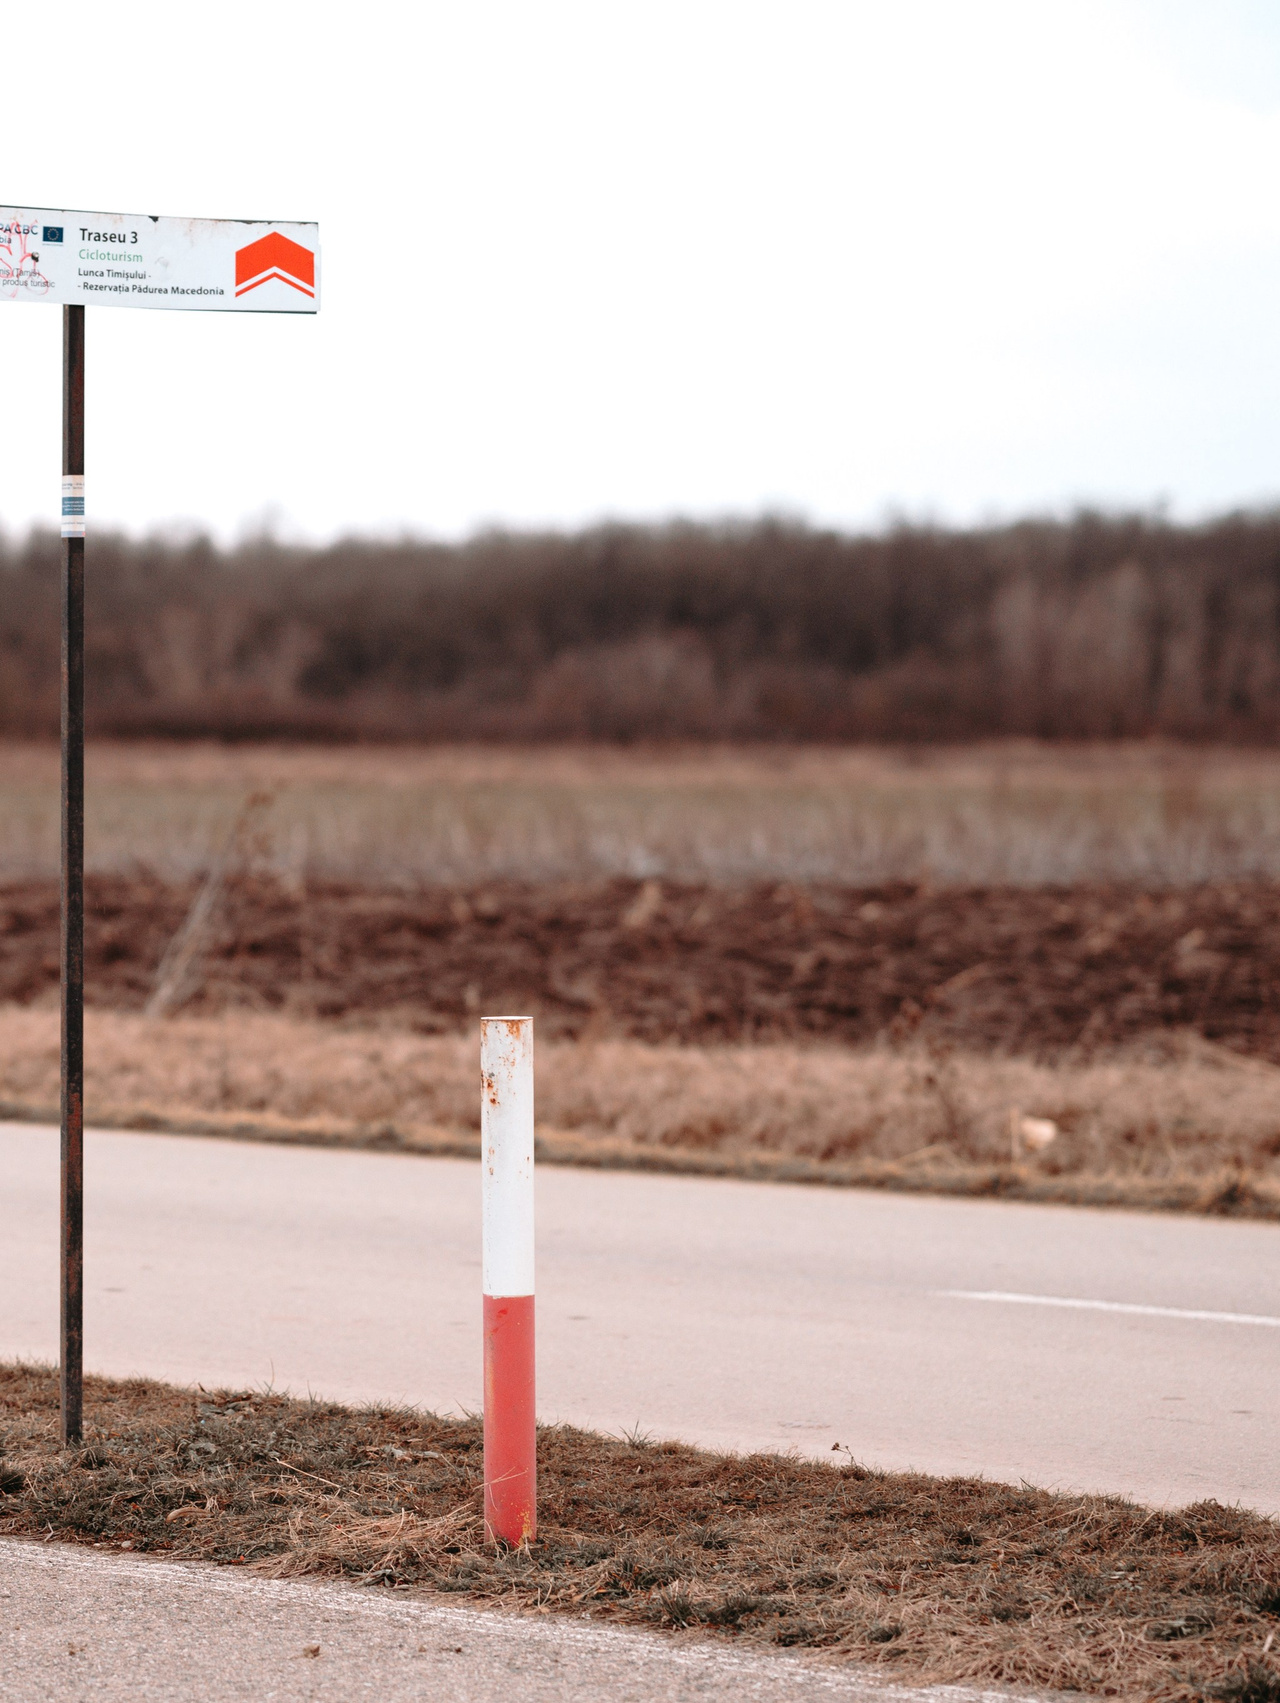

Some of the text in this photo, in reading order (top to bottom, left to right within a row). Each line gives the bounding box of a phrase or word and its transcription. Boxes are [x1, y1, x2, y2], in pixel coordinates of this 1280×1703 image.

[14, 223, 39, 235] CBC
[79, 228, 138, 244] Traseu 3
[78, 249, 143, 263] Cicloturism
[78, 268, 104, 277] Lunca
[106, 269, 147, 281] Timișului
[2, 277, 28, 288] produs
[30, 278, 56, 288] turistic
[82, 282, 130, 295] Rezervația
[131, 284, 169, 295] Pădurea
[170, 286, 225, 296] Macedonia
